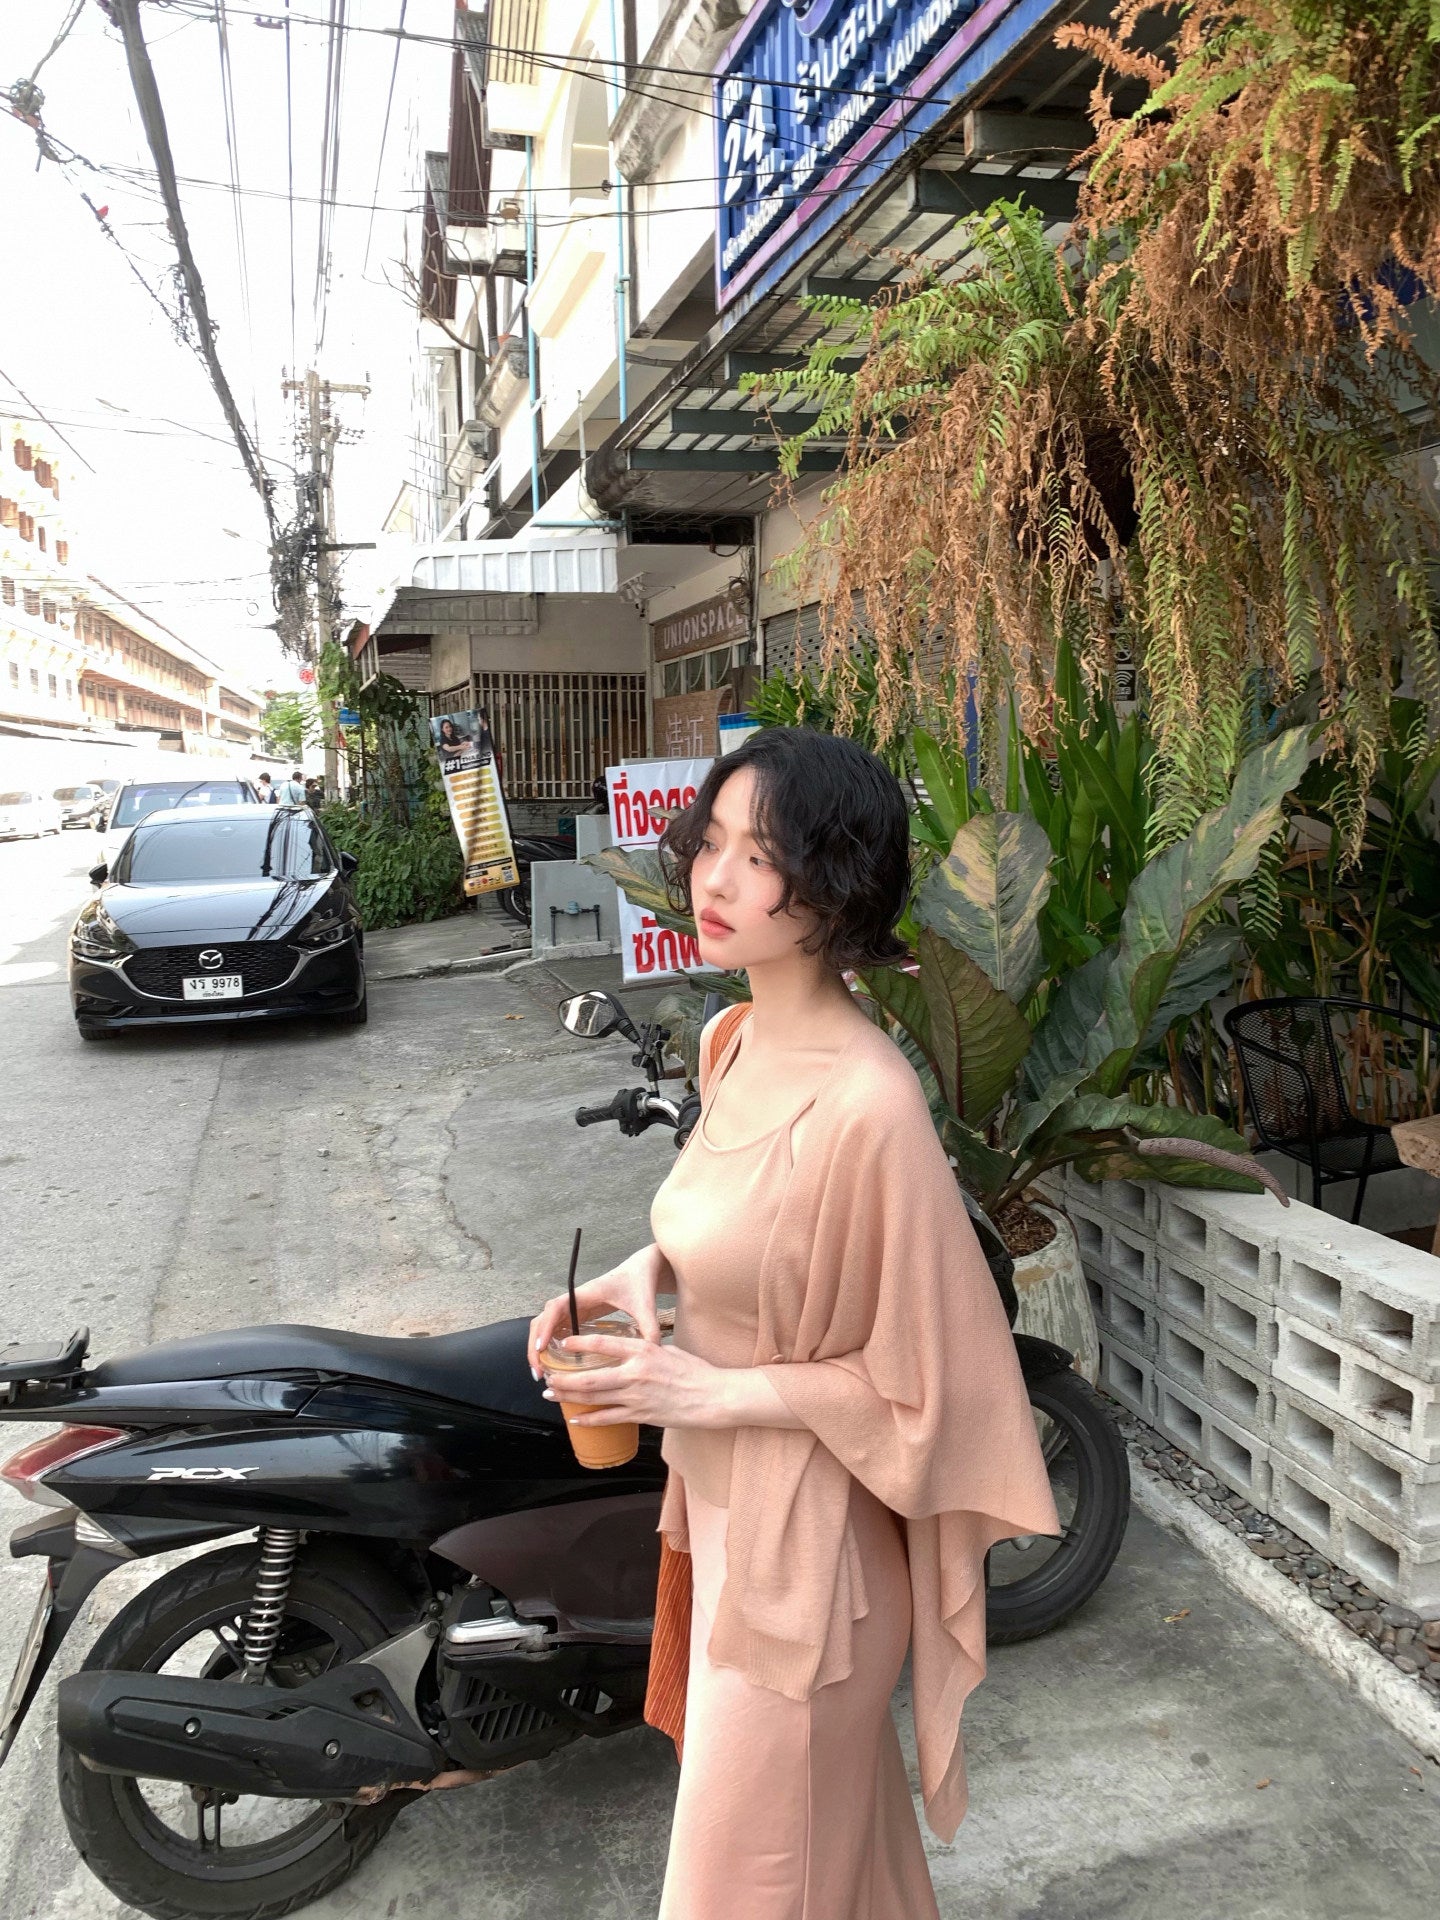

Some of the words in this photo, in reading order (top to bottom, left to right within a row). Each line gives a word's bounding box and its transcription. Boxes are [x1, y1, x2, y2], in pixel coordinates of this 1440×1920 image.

[723, 83, 766, 205] 24
[791, 141, 818, 192] SELF
[211, 977, 240, 989] 9978
[146, 1466, 260, 1481] PCX
